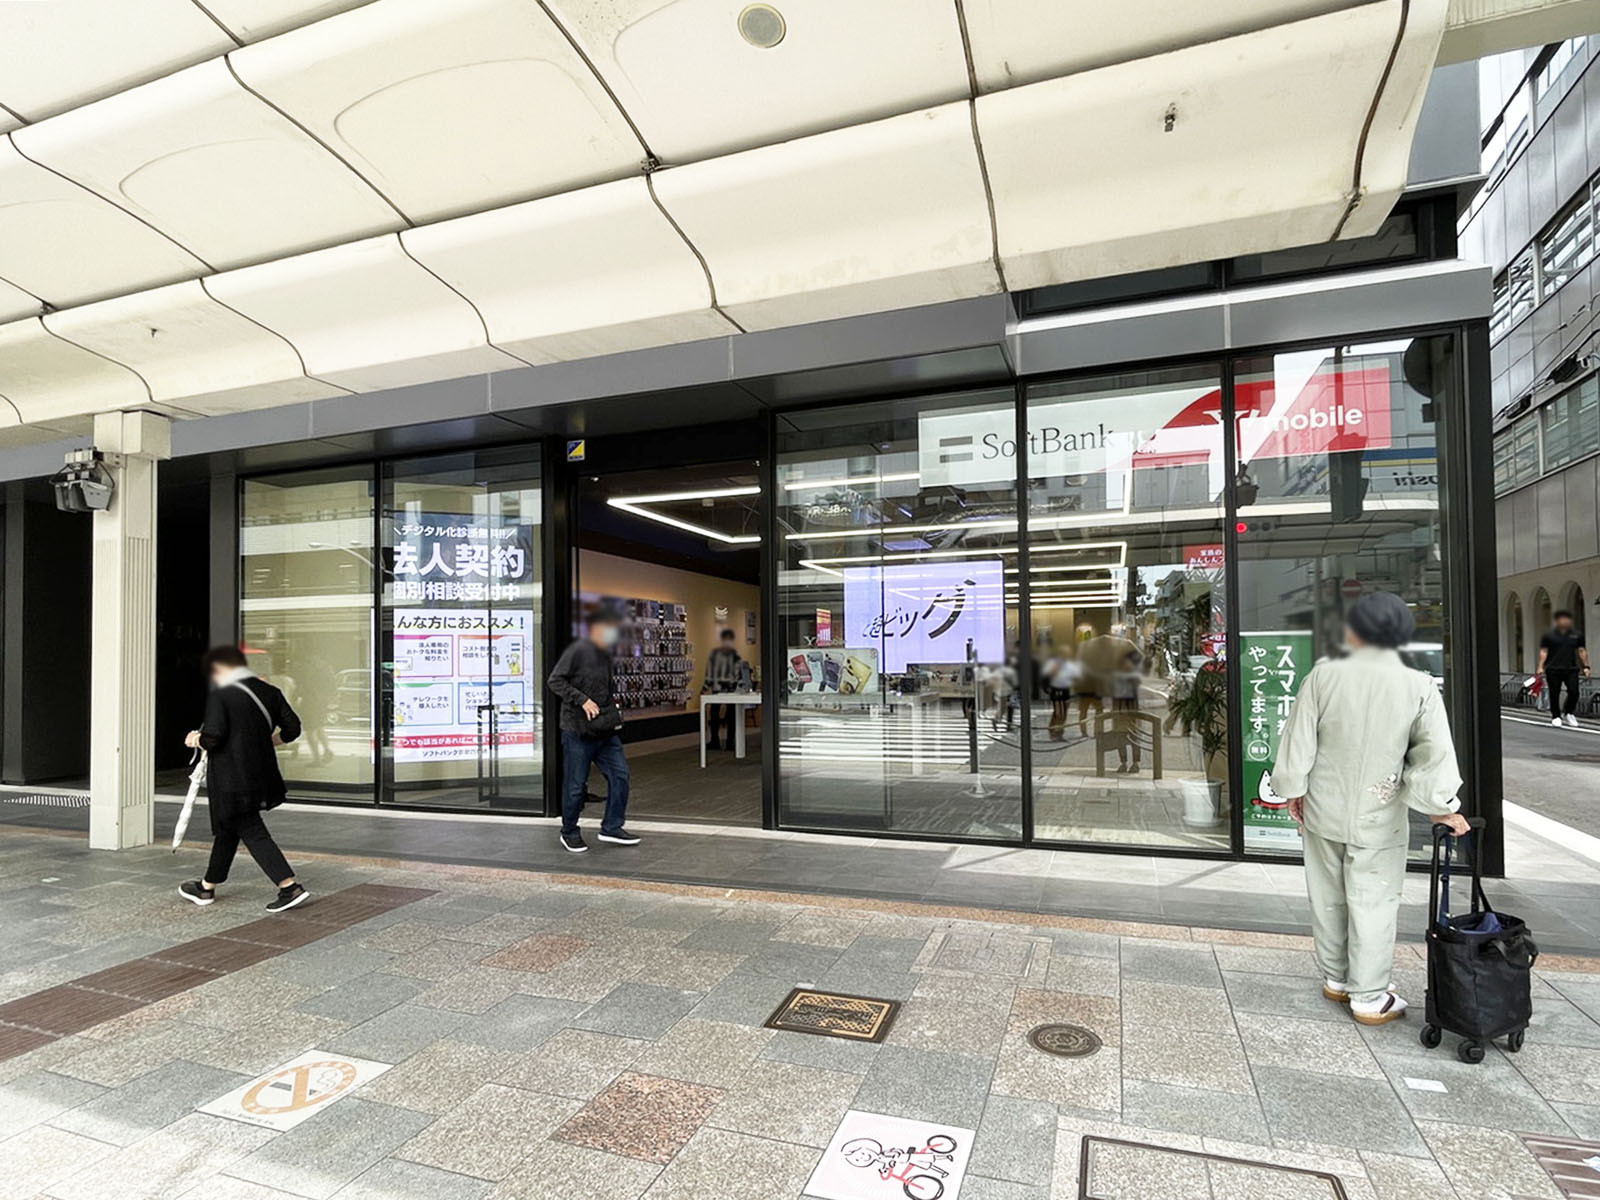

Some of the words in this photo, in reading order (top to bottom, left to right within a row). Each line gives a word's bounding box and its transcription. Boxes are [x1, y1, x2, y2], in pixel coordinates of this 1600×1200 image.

[982, 424, 1113, 459] SotBank
[394, 616, 524, 630] んな方におススメ！
[1248, 646, 1269, 739] やってます。
